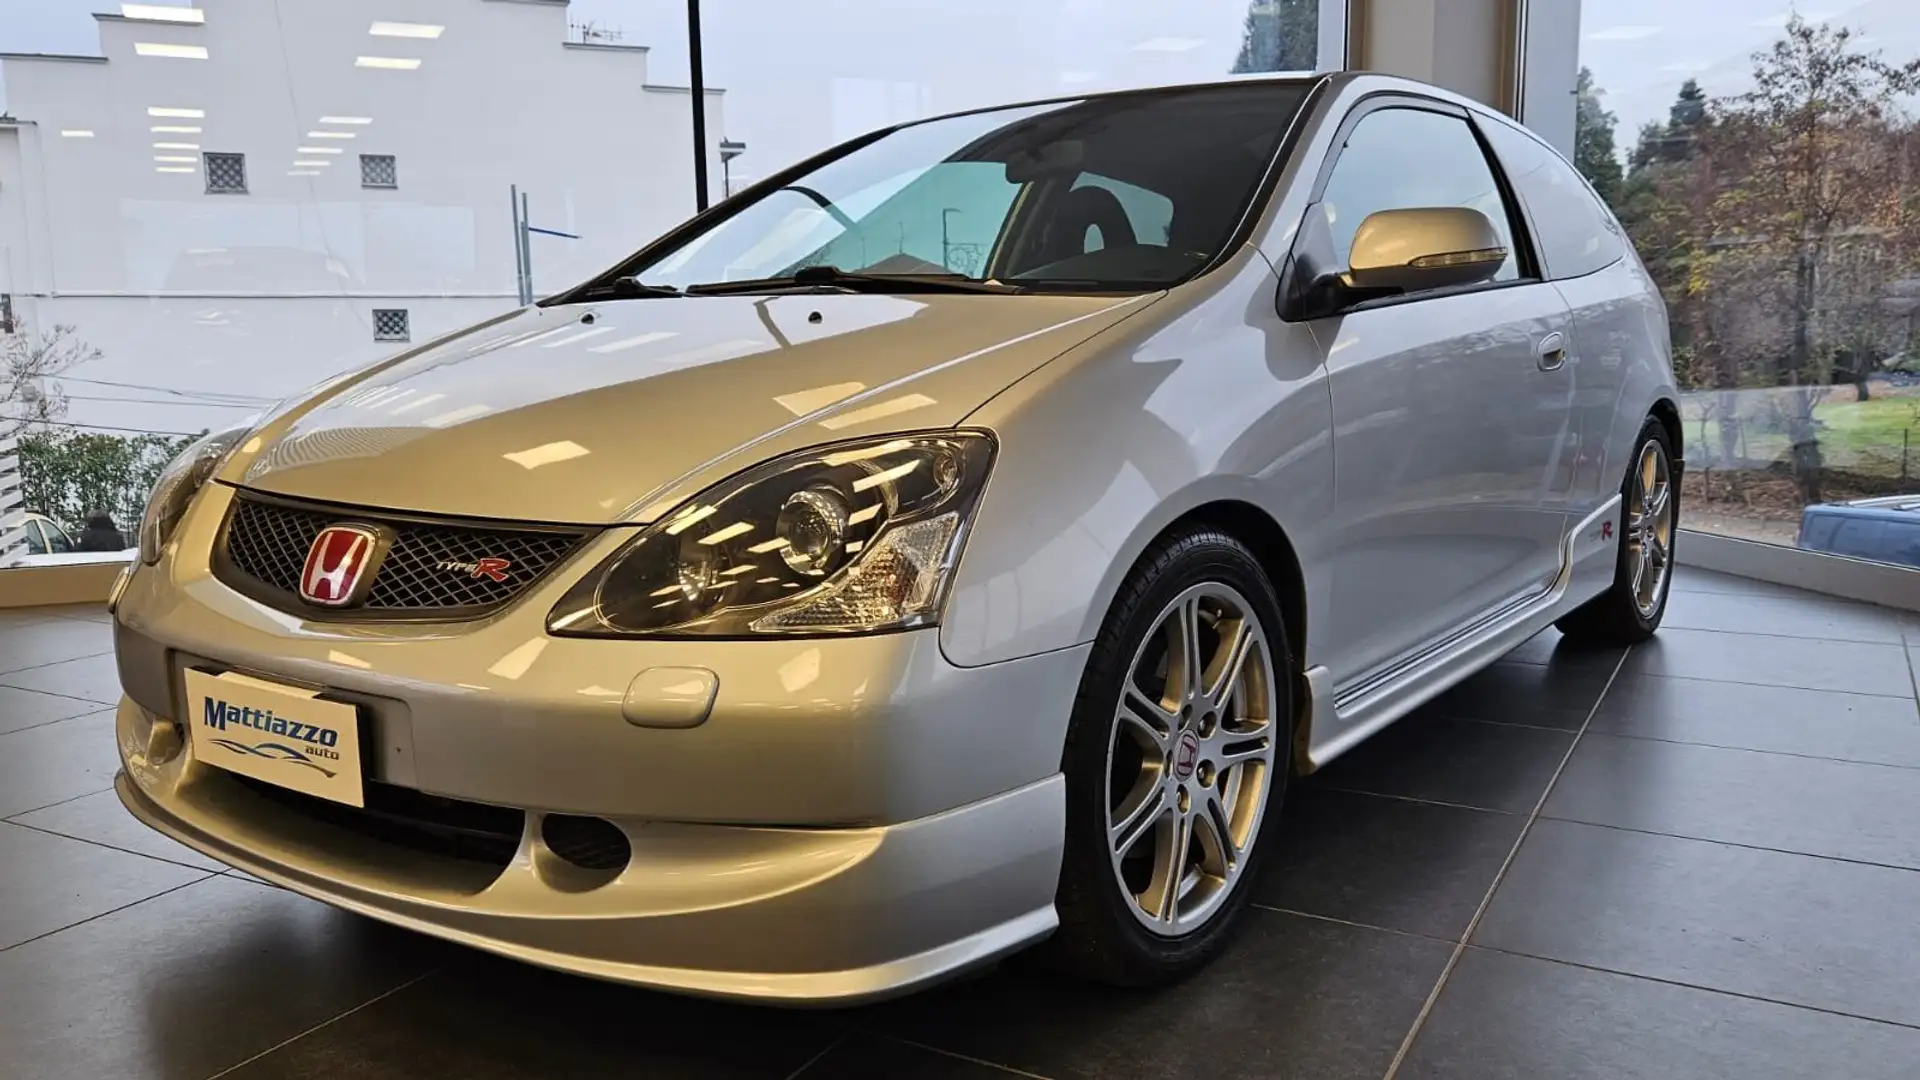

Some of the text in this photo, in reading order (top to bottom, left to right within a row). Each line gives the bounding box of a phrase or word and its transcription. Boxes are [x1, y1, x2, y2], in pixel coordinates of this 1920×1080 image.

[470, 557, 511, 582] R
[204, 696, 338, 747] Mattiazzo
[305, 745, 340, 760] auto
